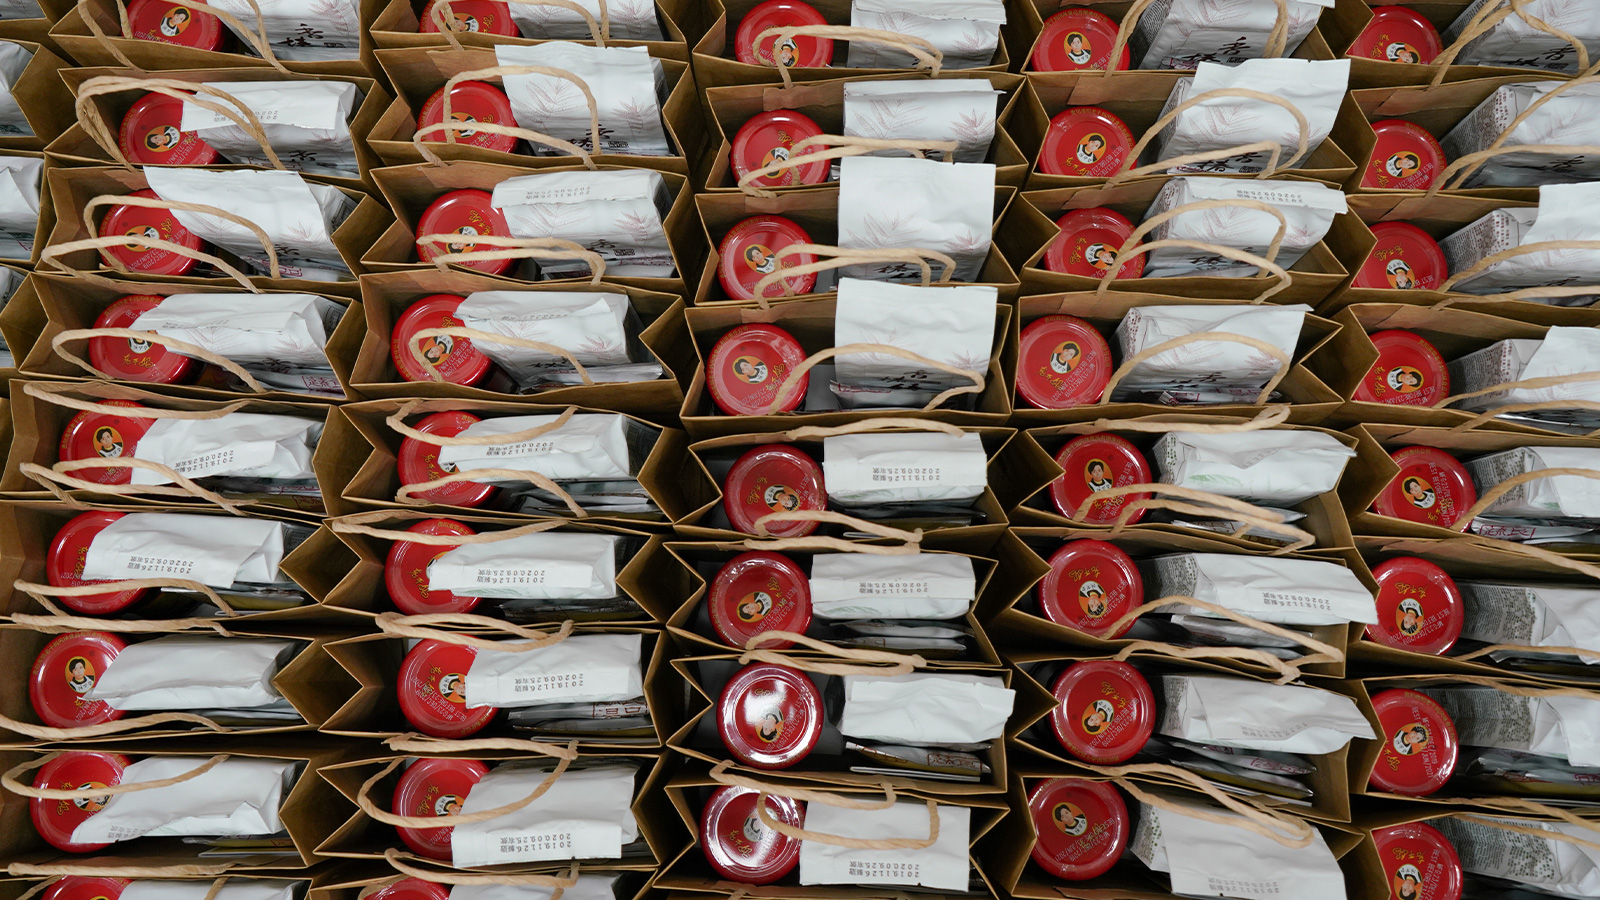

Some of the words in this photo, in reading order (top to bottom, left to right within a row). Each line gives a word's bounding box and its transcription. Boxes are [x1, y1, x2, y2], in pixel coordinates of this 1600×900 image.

[1112, 146, 1124, 157] BEST
[1422, 163, 1434, 173] BEST
[1421, 275, 1433, 283] BEST
[1085, 349, 1097, 362] BEST
[1423, 386, 1435, 395] BEST
[1123, 461, 1133, 475] BEST
[1429, 462, 1437, 475] BEST
[1117, 579, 1128, 591] BEST
[1437, 608, 1450, 619] BEST
[1127, 697, 1140, 709] BEST
[454, 710, 467, 721] BEST
[1412, 706, 1420, 720] BEST
[1430, 849, 1439, 863] BEST
